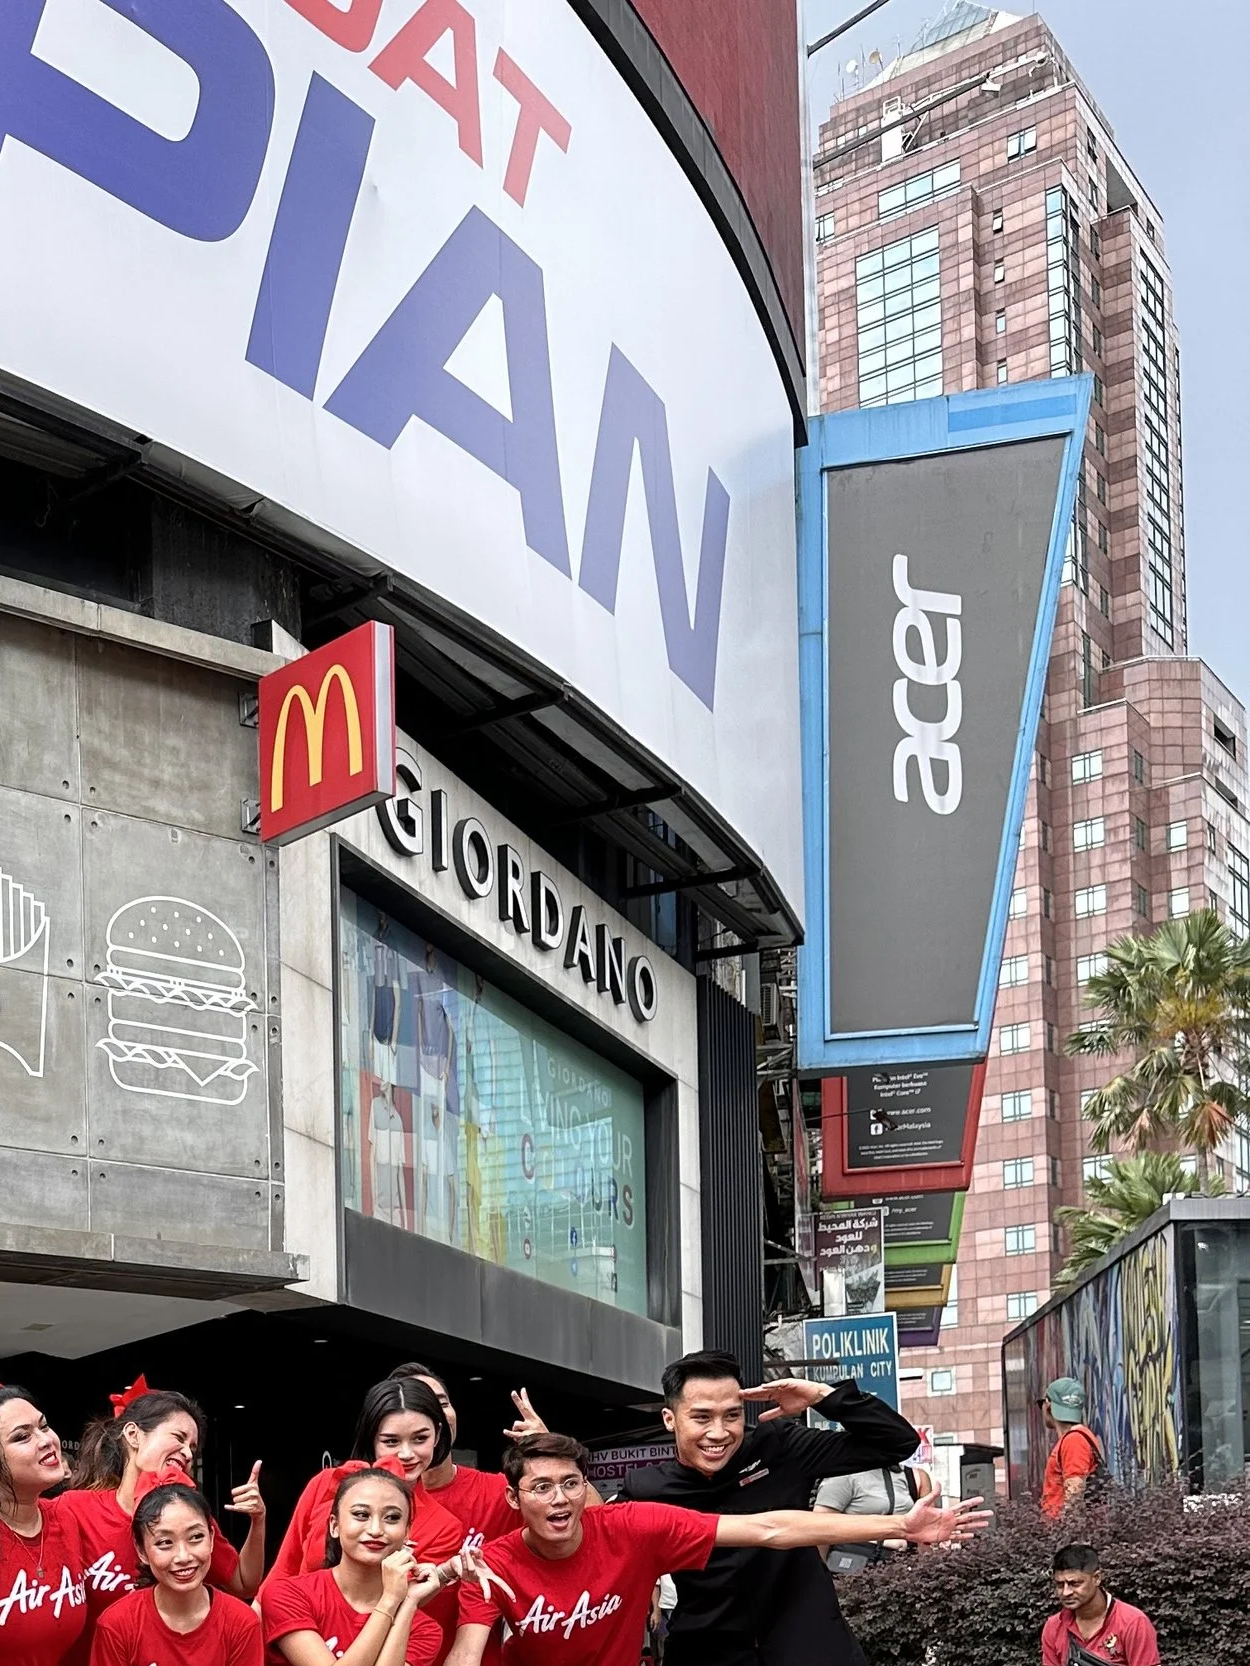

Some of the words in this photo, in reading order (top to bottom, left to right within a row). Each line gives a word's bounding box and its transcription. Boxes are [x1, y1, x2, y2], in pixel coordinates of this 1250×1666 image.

[892, 553, 962, 816] acer
[375, 746, 658, 1023] GIORDANO
[547, 1057, 610, 1107] GIORDANO
[812, 1327, 890, 1360] POLIKLINIK
[813, 1362, 864, 1381] KUMPULAN
[870, 1360, 892, 1378] CITY
[612, 1448, 647, 1460] BUKIT
